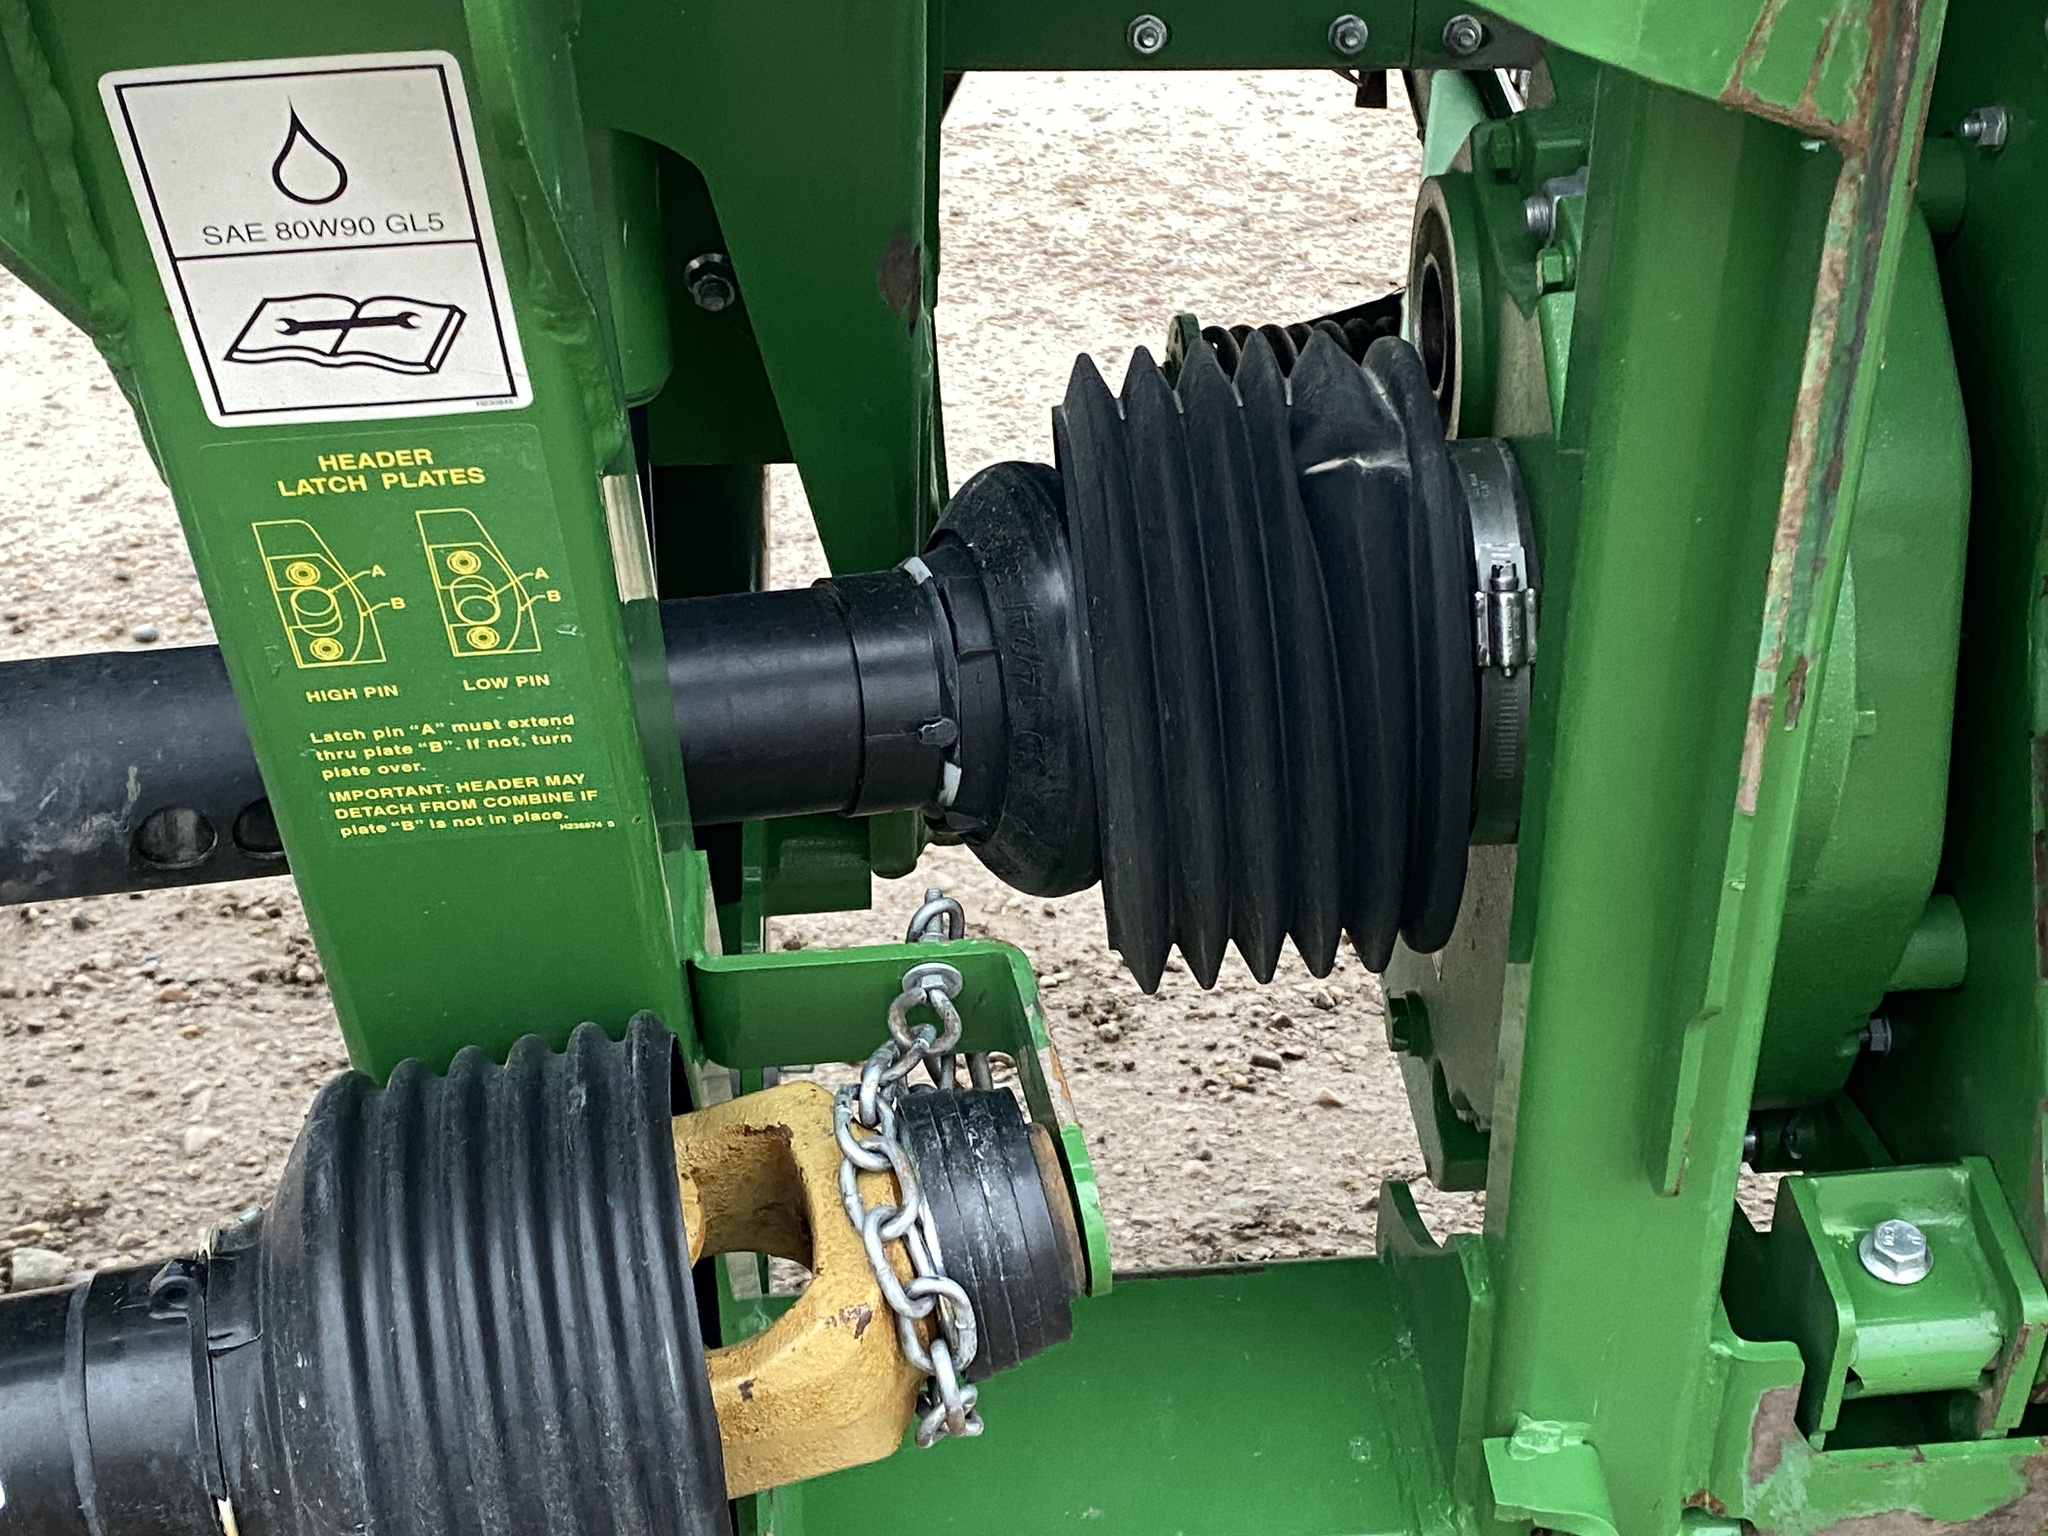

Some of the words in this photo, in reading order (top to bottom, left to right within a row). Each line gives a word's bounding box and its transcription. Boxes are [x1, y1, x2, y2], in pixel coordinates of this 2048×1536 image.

[202, 222, 267, 246] SAE
[274, 216, 376, 241] 80W90
[385, 212, 445, 234] GL5
[317, 448, 434, 472] HEADER
[277, 474, 368, 497] LATCH
[381, 466, 486, 490] PLATES
[371, 564, 387, 578] A
[534, 567, 550, 580] A
[390, 596, 406, 610] B
[546, 589, 562, 603] B
[305, 687, 358, 703] HIGH
[363, 684, 399, 699] PIN
[462, 676, 509, 691] LOW
[515, 673, 550, 688] PIN
[309, 729, 366, 744] Latch
[372, 726, 405, 742] pin
[451, 718, 502, 733] must
[507, 713, 575, 729] extend
[315, 749, 357, 762] thru
[363, 744, 413, 760] plate
[466, 737, 480, 750] If
[487, 735, 526, 749] not,
[530, 733, 573, 746] turn
[321, 765, 371, 782] plate
[377, 762, 426, 775] over.
[328, 783, 451, 803] IMPORTANT:
[455, 776, 540, 793] HEADER
[544, 773, 585, 786] MAY
[334, 803, 415, 820] DETACH
[419, 798, 478, 813] FROM
[482, 791, 576, 808] COMBINE
[580, 789, 598, 802] IF
[340, 823, 388, 839] plate
[429, 818, 447, 829] is
[452, 815, 484, 828] not
[488, 813, 507, 825] in
[512, 811, 569, 825] place.
